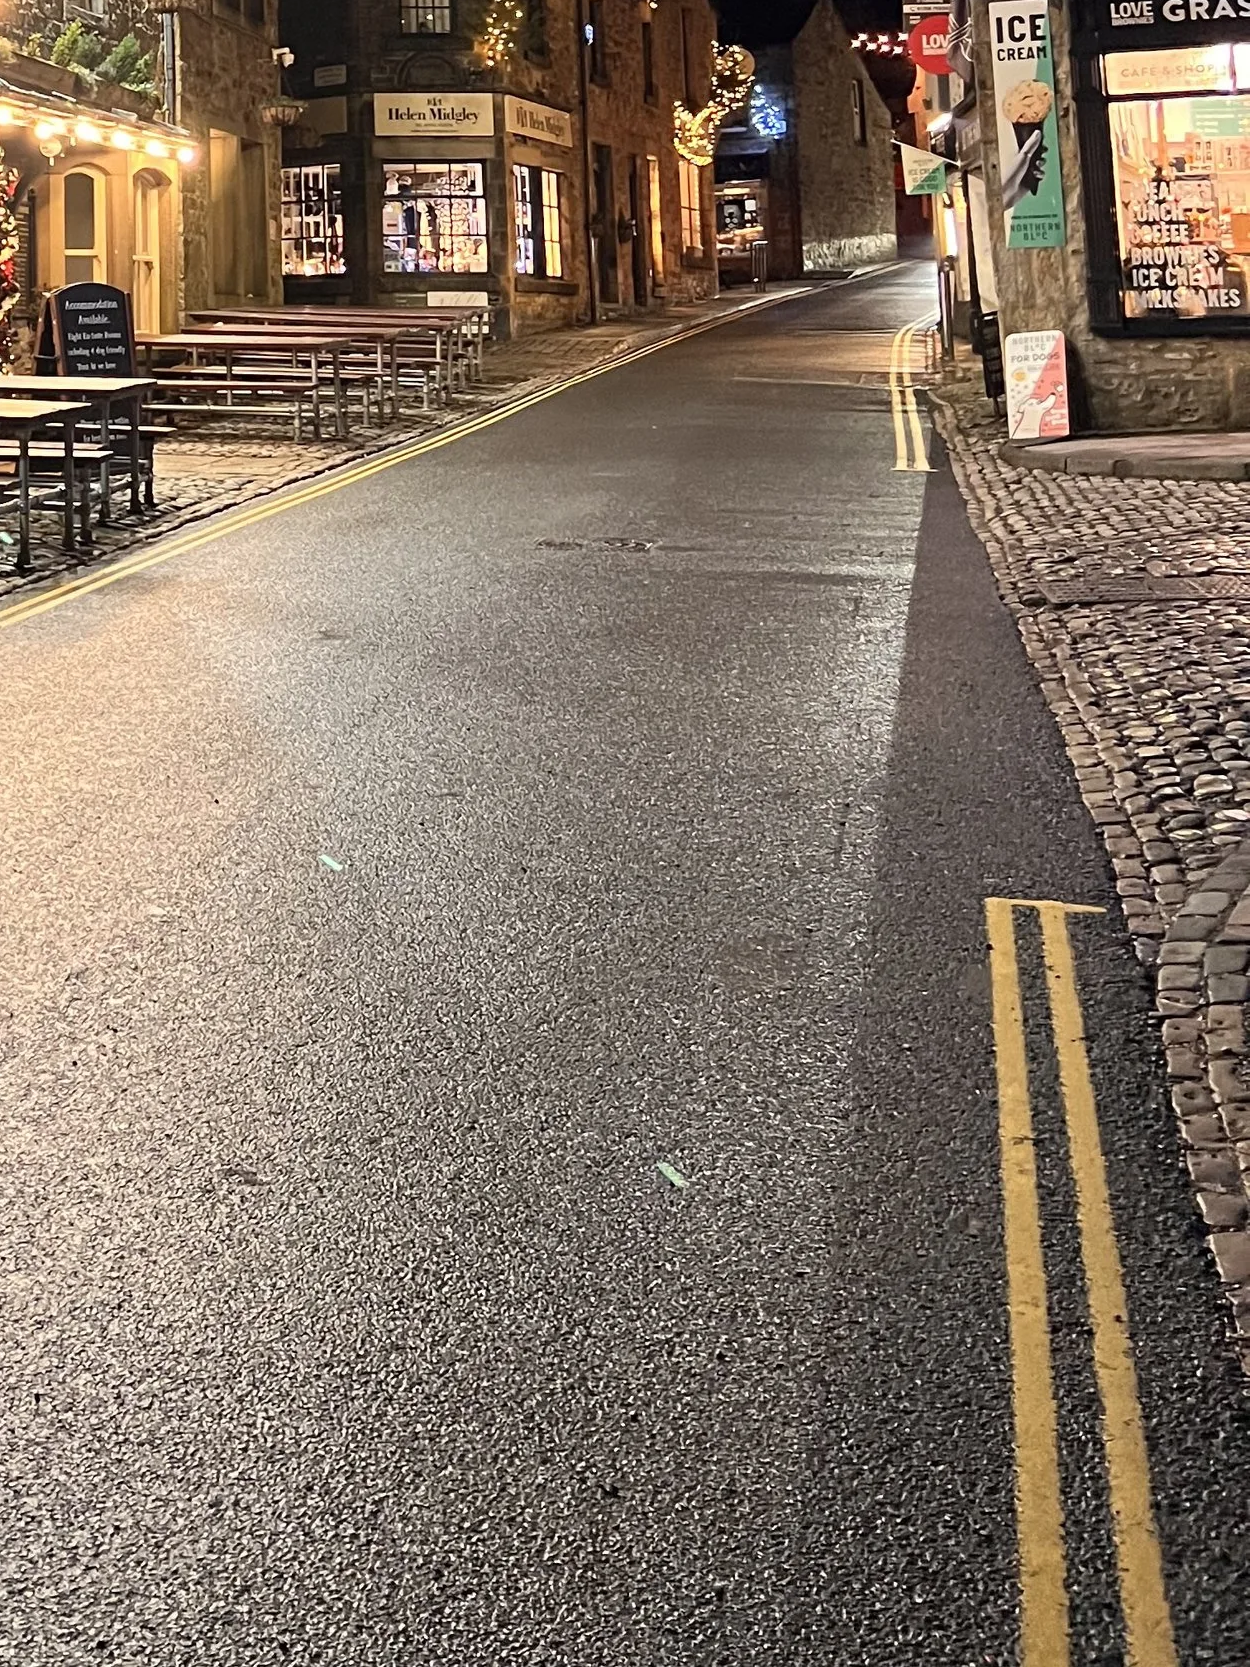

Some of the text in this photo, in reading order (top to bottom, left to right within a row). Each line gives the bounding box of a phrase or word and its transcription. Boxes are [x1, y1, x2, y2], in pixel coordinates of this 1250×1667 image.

[1110, 0, 1154, 19] LOVE
[995, 14, 1047, 43] ICE
[922, 34, 951, 49] LOV
[997, 45, 1048, 62] CREAM
[1163, 66, 1171, 75] &
[1175, 64, 1215, 75] SHOP
[388, 107, 480, 125] Helen Midgley
[1011, 222, 1061, 232] NORTHERN
[1130, 245, 1220, 265] BROWNIES
[1132, 266, 1224, 287] ICE CREAM
[1010, 351, 1061, 363] FOR DOGS
